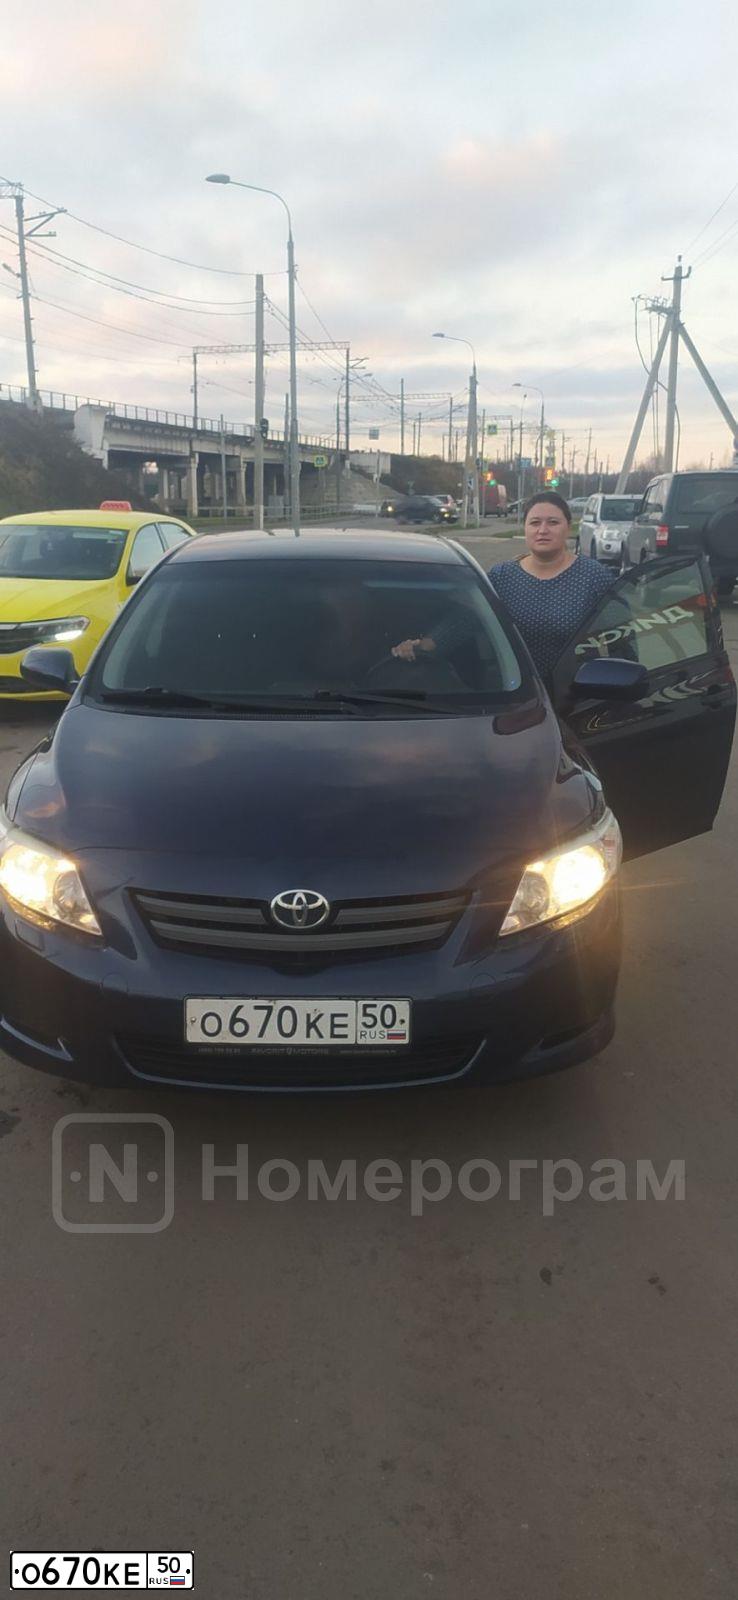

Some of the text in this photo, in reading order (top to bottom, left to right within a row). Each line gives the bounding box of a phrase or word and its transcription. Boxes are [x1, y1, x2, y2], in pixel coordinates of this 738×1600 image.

[200, 1003, 397, 1039] О670КЕ 50
[359, 1030, 386, 1040] RUS
